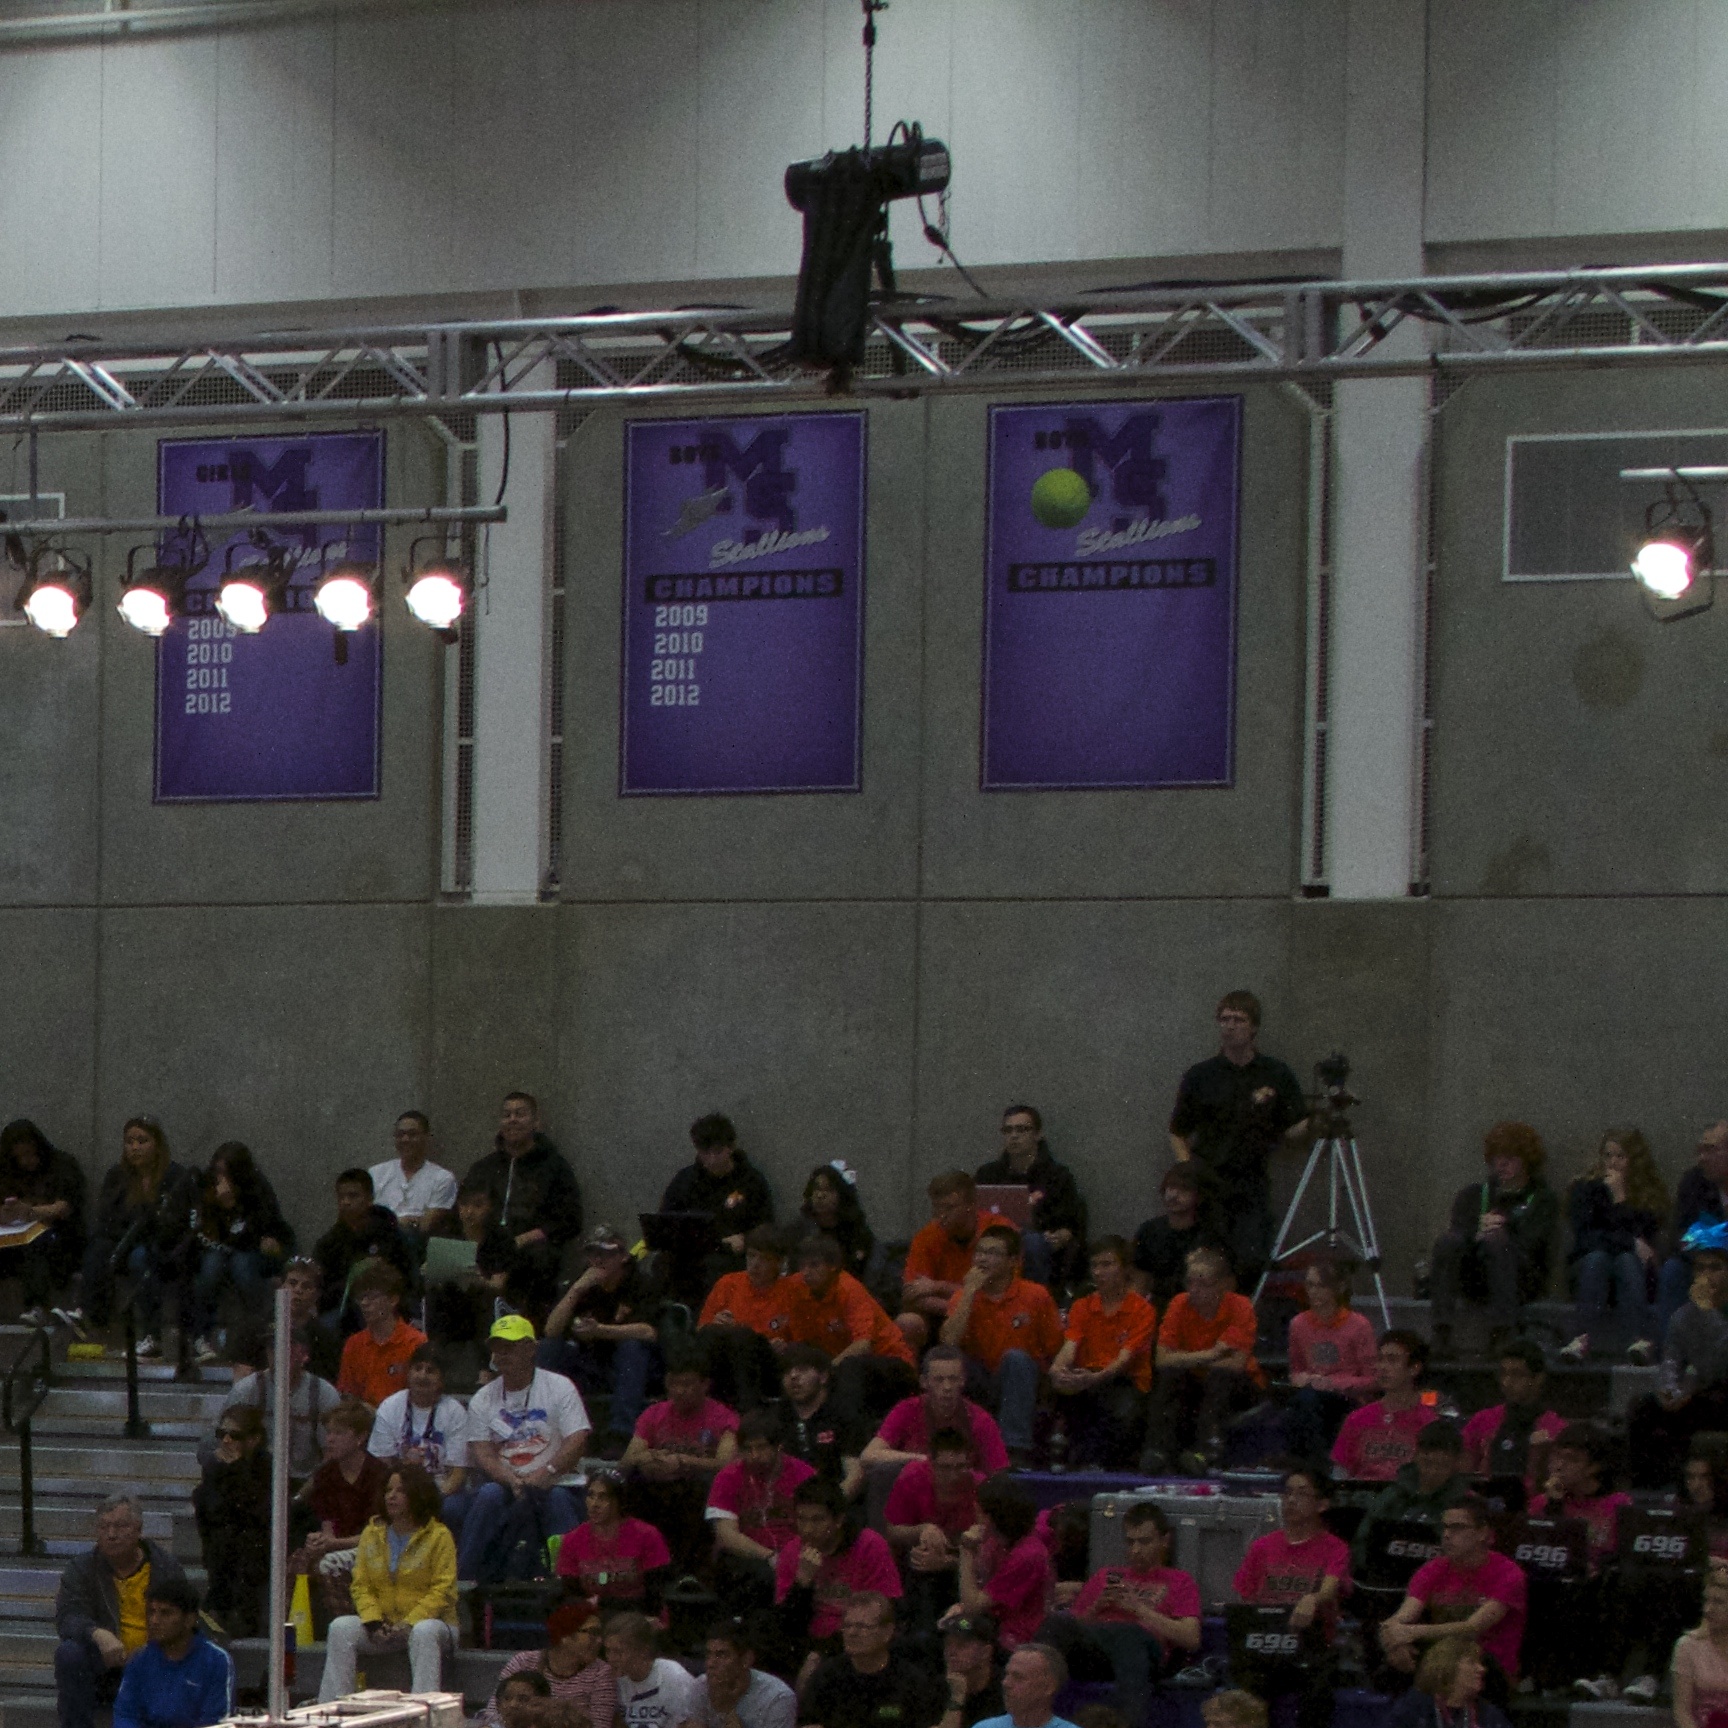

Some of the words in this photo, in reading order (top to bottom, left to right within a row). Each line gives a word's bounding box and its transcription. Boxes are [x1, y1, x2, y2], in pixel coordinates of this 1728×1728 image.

[654, 574, 835, 598] CHAMPIONS
[1017, 564, 1207, 587] CHAMPIONS
[654, 605, 709, 627] 2009
[187, 643, 232, 664] 2010
[653, 632, 704, 654] 2010
[186, 668, 228, 689] 2011
[650, 659, 695, 681] 2011
[185, 693, 231, 714] 2012
[650, 684, 700, 706] 2012
[1515, 1543, 1569, 1566] 696
[1632, 1535, 1688, 1554] 696
[1244, 1632, 1300, 1651] 696
